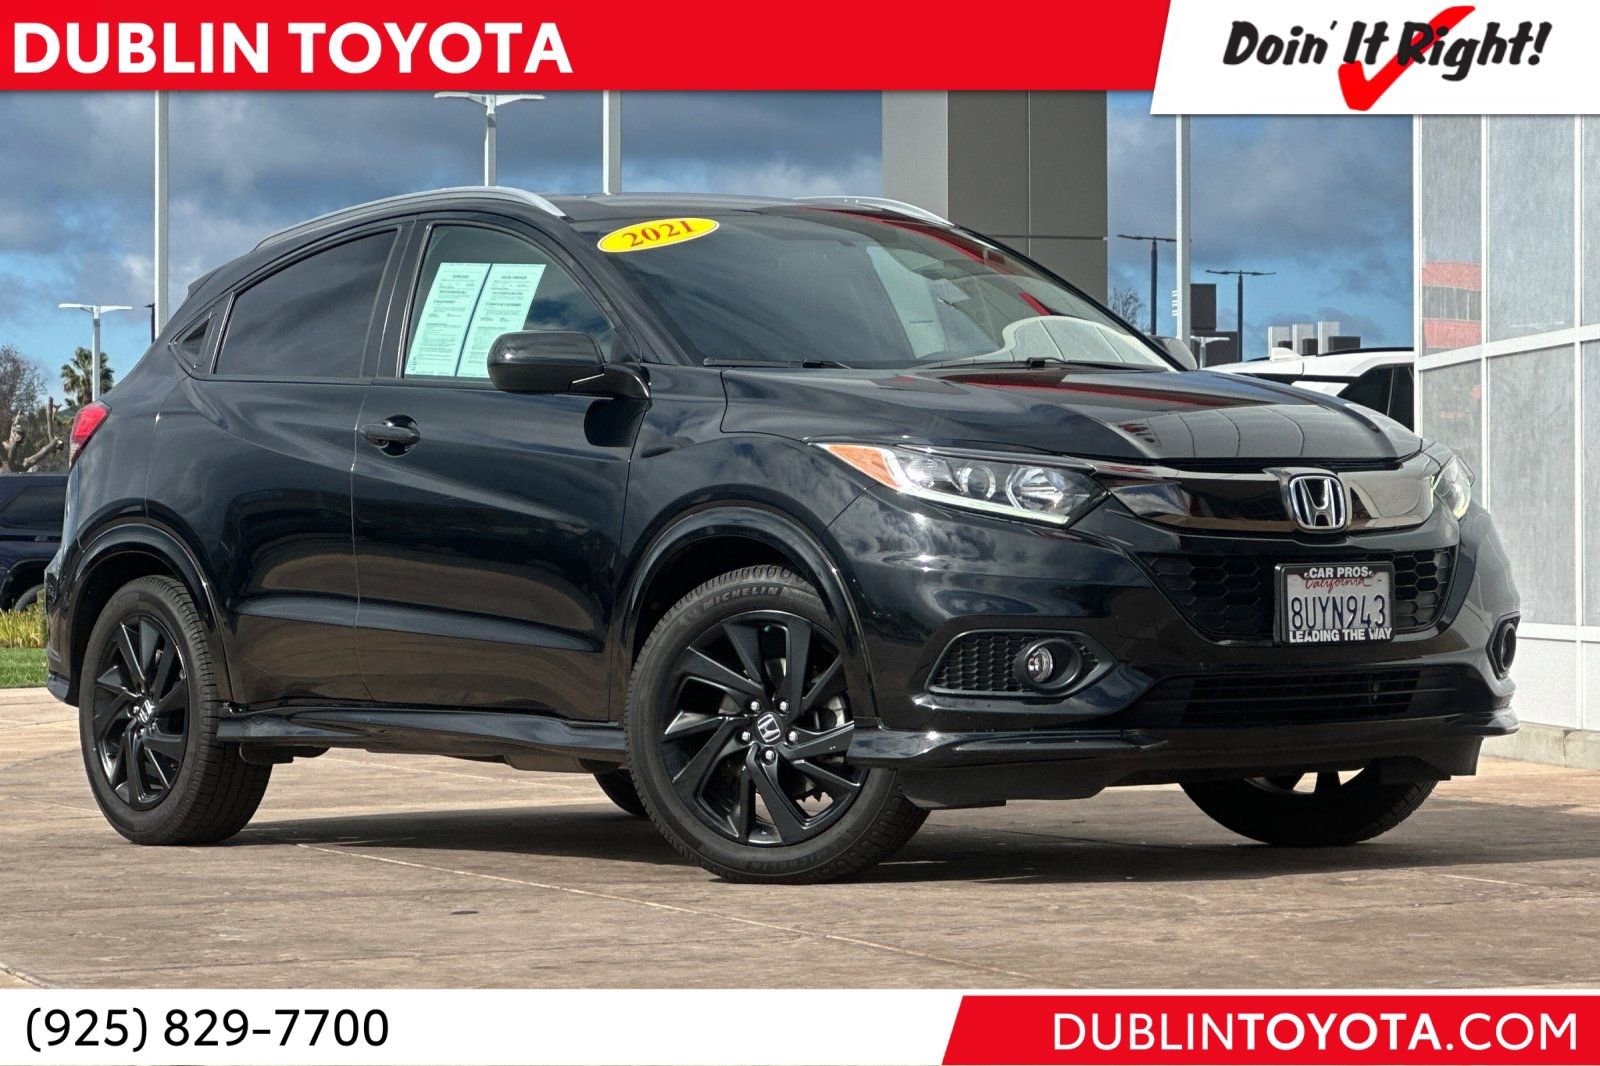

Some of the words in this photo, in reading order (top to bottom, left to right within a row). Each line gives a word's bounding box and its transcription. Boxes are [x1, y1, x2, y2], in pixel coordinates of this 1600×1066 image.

[621, 219, 696, 248] 2021
[1308, 567, 1336, 579] CAR
[1336, 566, 1369, 578] PROS
[703, 586, 779, 609] MICHELIN
[1291, 595, 1386, 630] 8UYN943
[1289, 629, 1340, 643] LEADING
[1342, 628, 1366, 641] THE
[1368, 627, 1393, 641] WAY
